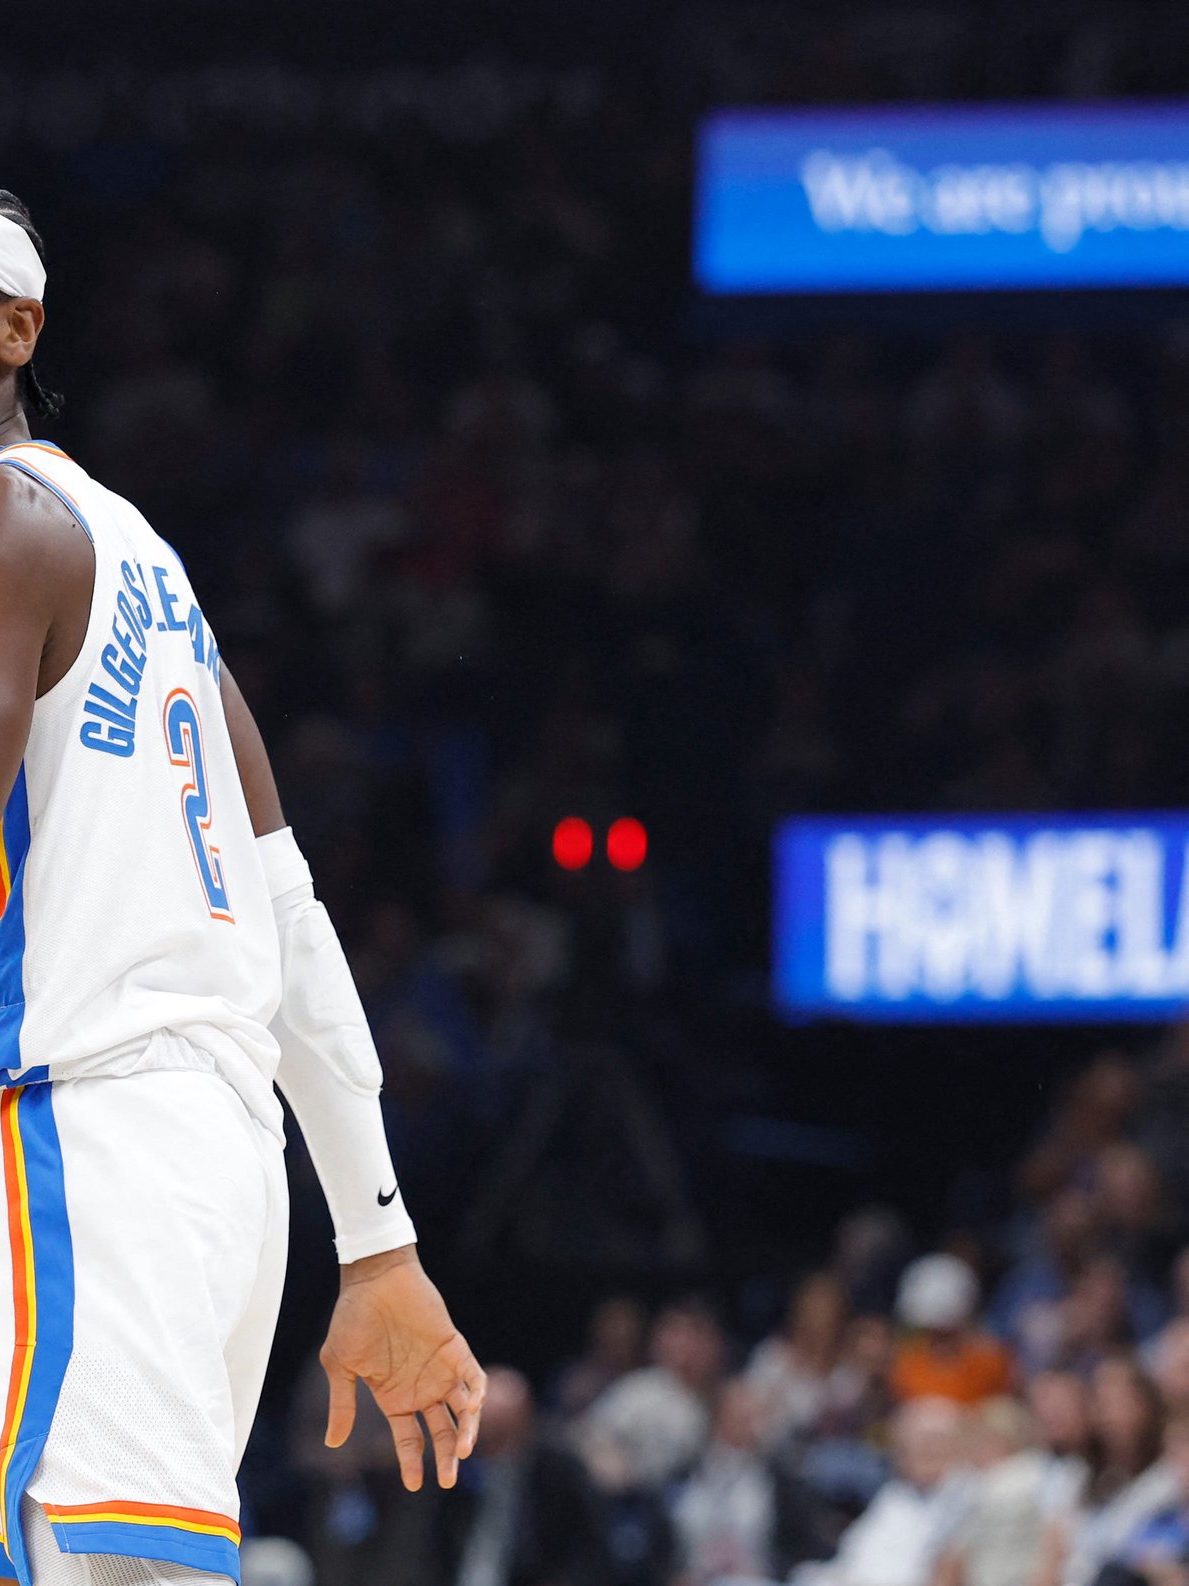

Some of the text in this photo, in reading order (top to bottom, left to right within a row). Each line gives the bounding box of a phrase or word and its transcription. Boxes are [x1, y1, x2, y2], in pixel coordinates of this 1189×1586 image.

[922, 163, 1038, 235] are
[163, 687, 236, 926] 2
[824, 829, 1189, 1002] HOMEL
